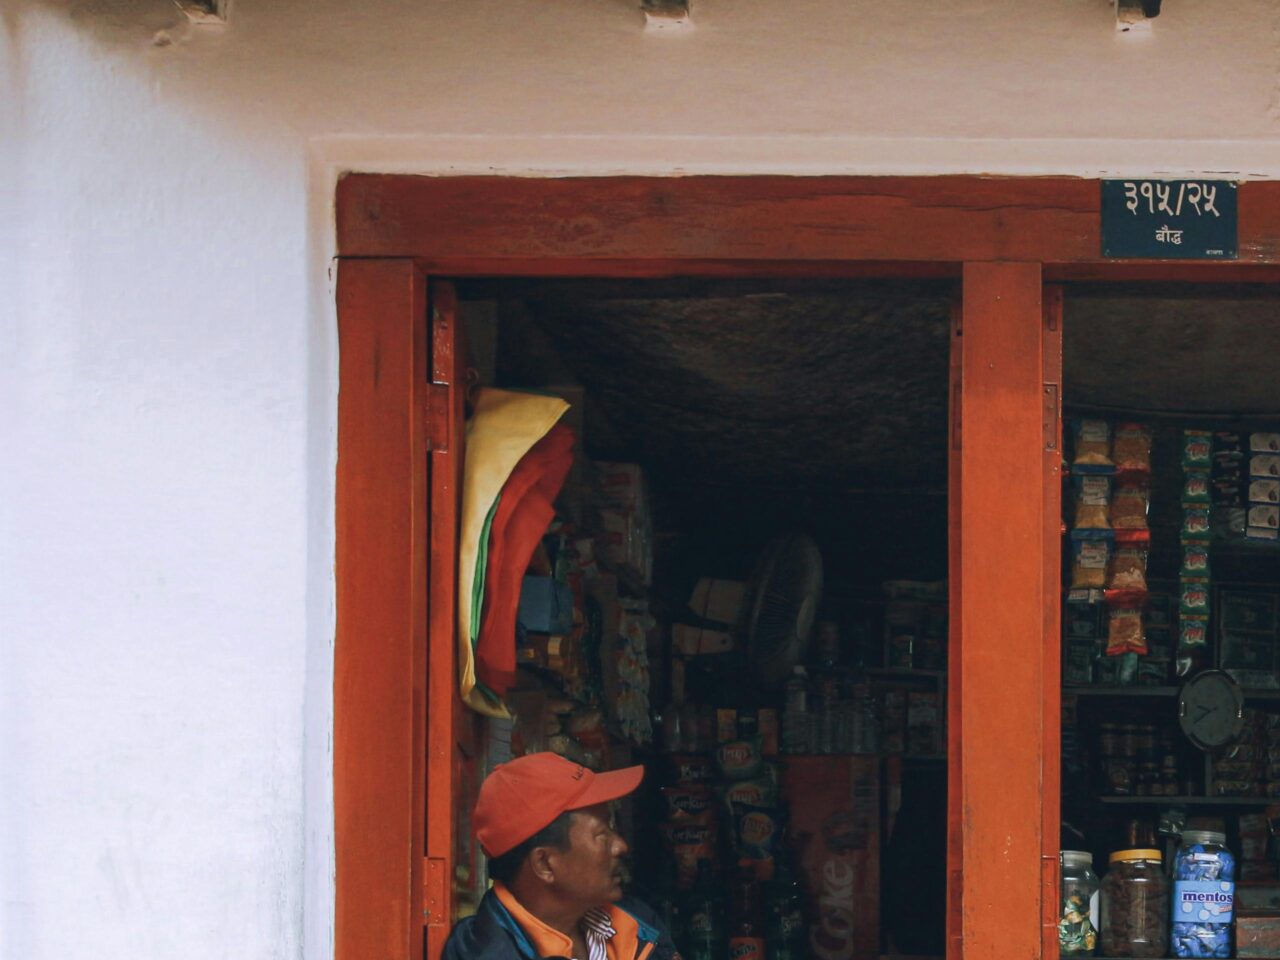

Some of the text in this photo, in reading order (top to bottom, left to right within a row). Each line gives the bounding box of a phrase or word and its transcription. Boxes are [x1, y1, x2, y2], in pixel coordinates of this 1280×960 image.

[1123, 182, 1220, 217] ३१५/२५
[1155, 225, 1183, 245] बौद्ध
[1182, 891, 1233, 903] mentos
